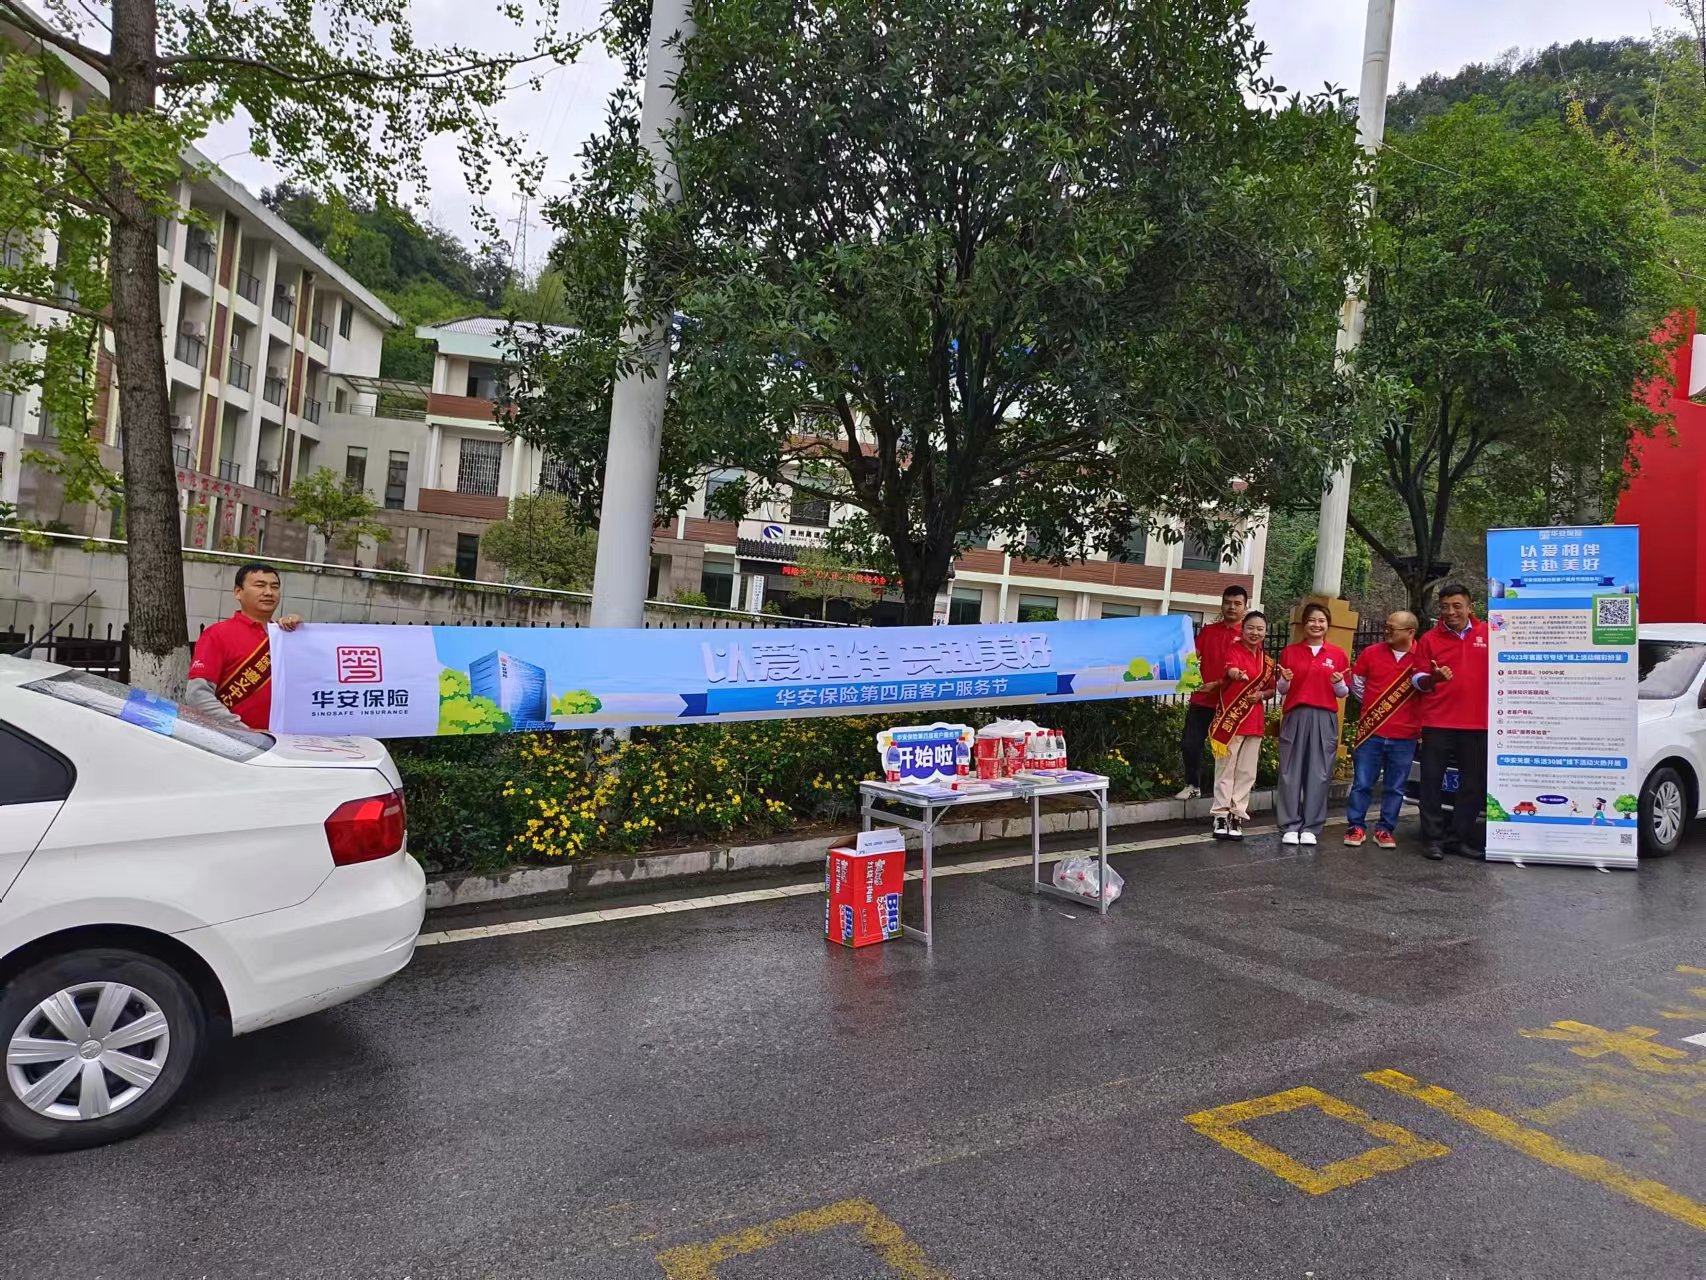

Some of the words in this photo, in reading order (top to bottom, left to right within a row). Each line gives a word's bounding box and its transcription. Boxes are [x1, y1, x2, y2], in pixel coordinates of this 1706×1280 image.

[1520, 543, 1600, 557] 以爱相伴
[1520, 558, 1599, 572] 共赴美好
[700, 640, 892, 683] 以爱相伴
[899, 632, 1052, 677] 共赴美好
[220, 667, 262, 707] 遵义中心
[312, 689, 409, 709] 华安保险
[775, 678, 1009, 708] 华安保险第四届客户服务节
[898, 744, 954, 769] 开始啦
[886, 894, 898, 931] BIG
